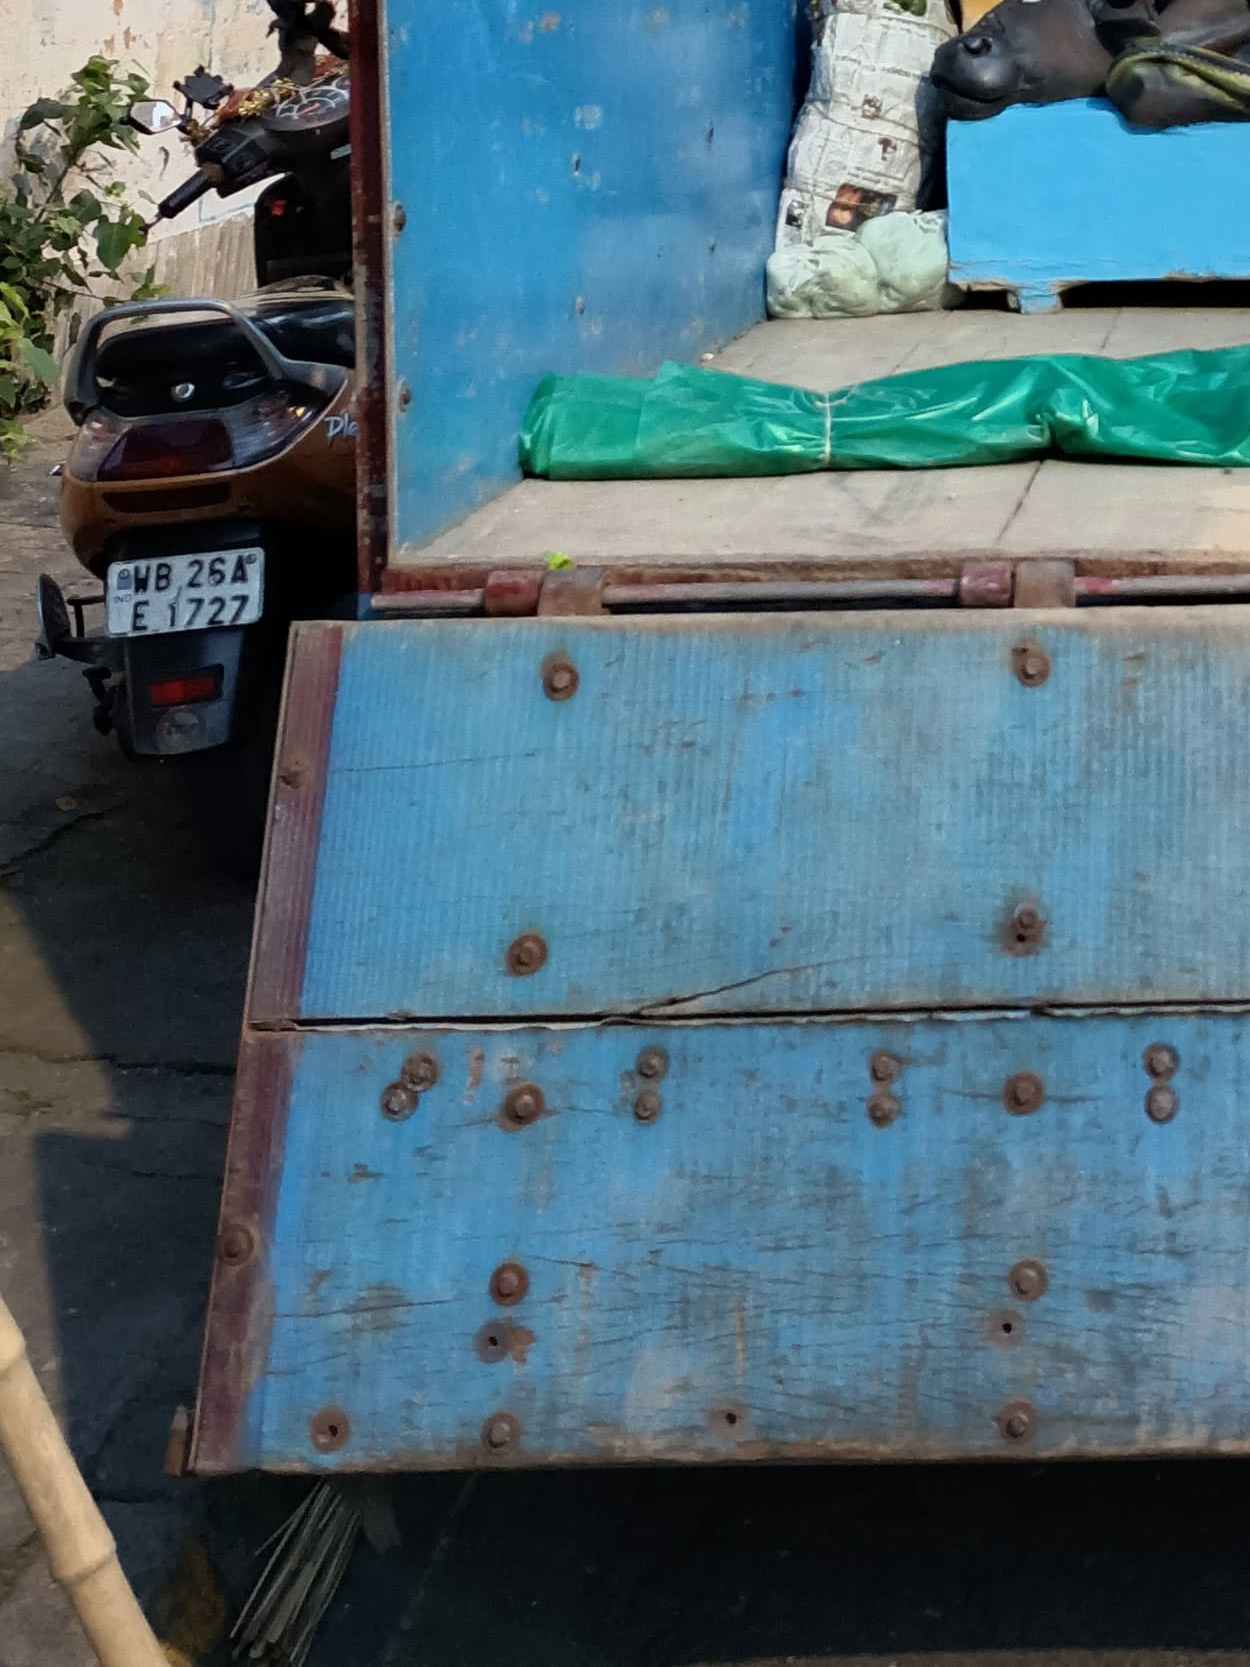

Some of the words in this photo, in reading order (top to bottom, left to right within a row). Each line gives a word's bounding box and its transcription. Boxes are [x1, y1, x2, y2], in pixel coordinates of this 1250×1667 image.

[134, 563, 172, 594] WB
[187, 555, 248, 588] 26A
[168, 594, 249, 628] 1727
